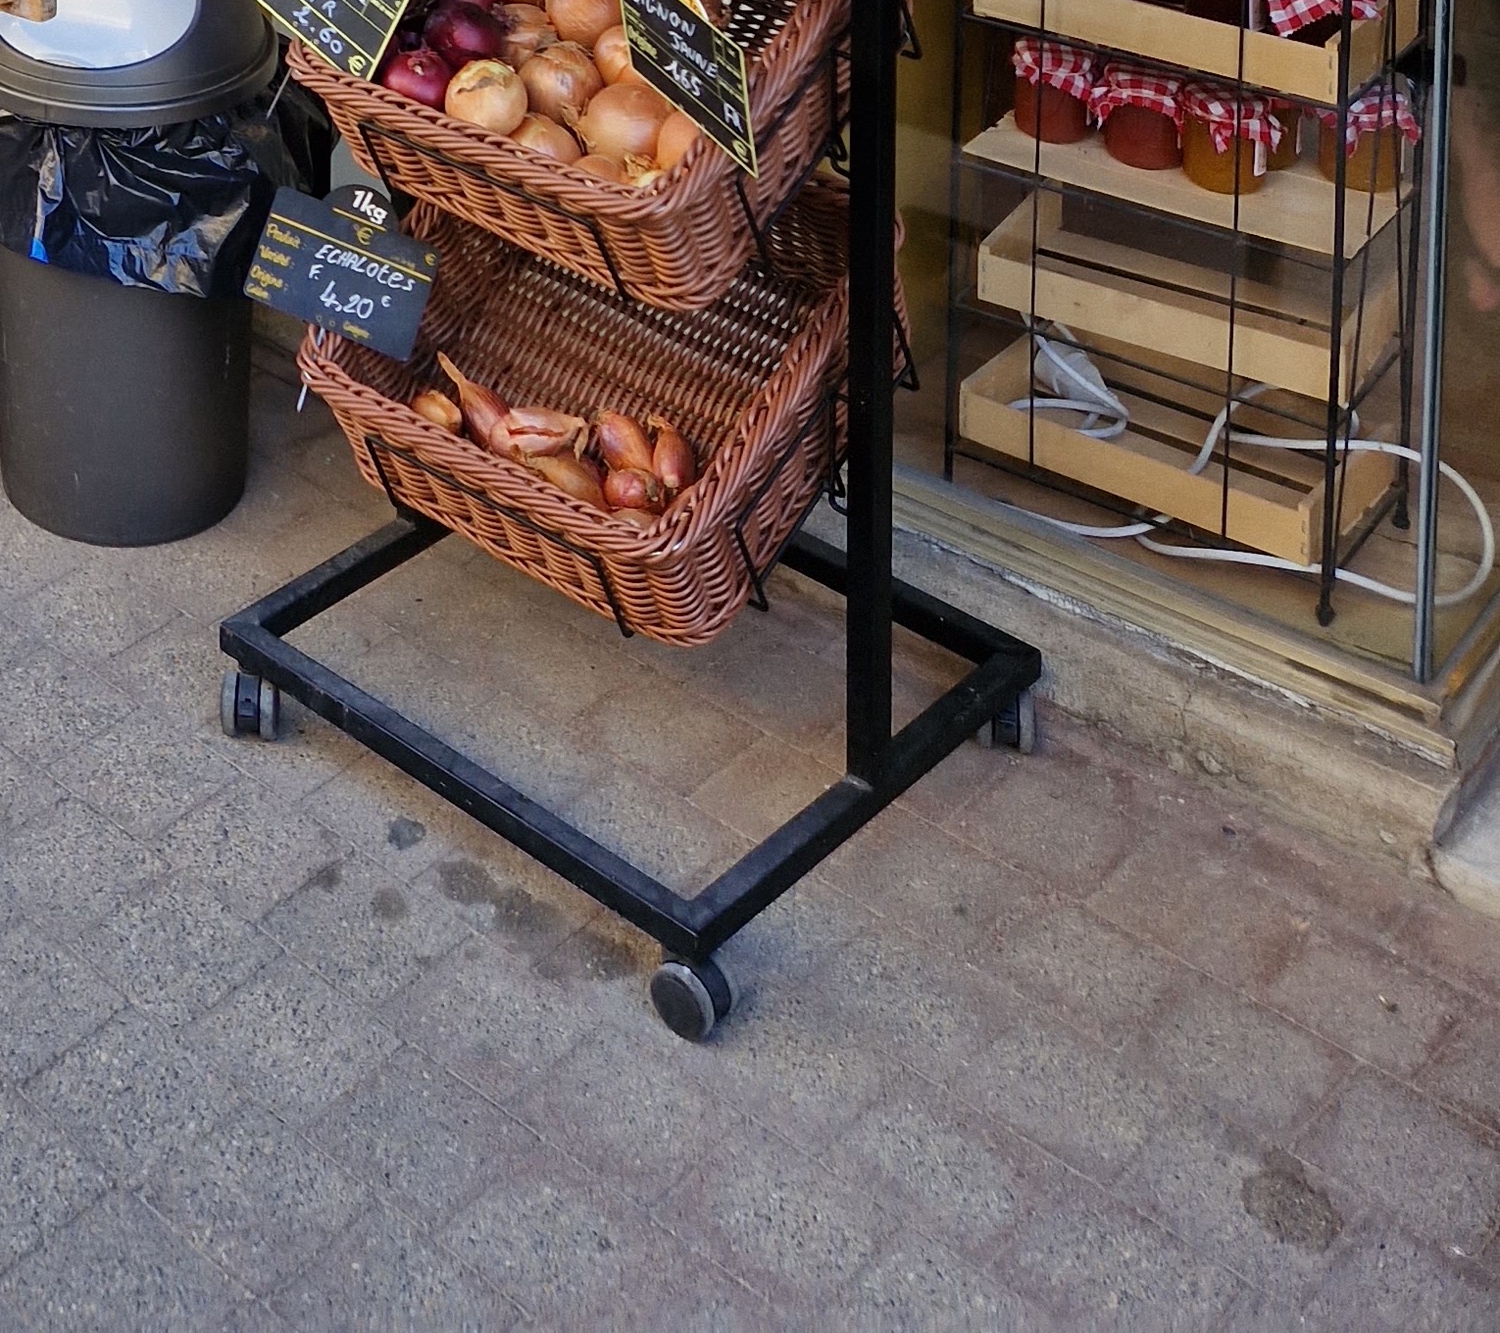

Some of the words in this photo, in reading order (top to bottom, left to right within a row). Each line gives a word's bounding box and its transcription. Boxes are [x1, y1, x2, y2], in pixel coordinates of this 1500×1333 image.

[348, 55, 367, 77] €
[667, 30, 720, 79] JAUNE
[351, 189, 389, 226] 1kg
[355, 226, 374, 247] €
[318, 279, 375, 320] 4,20
